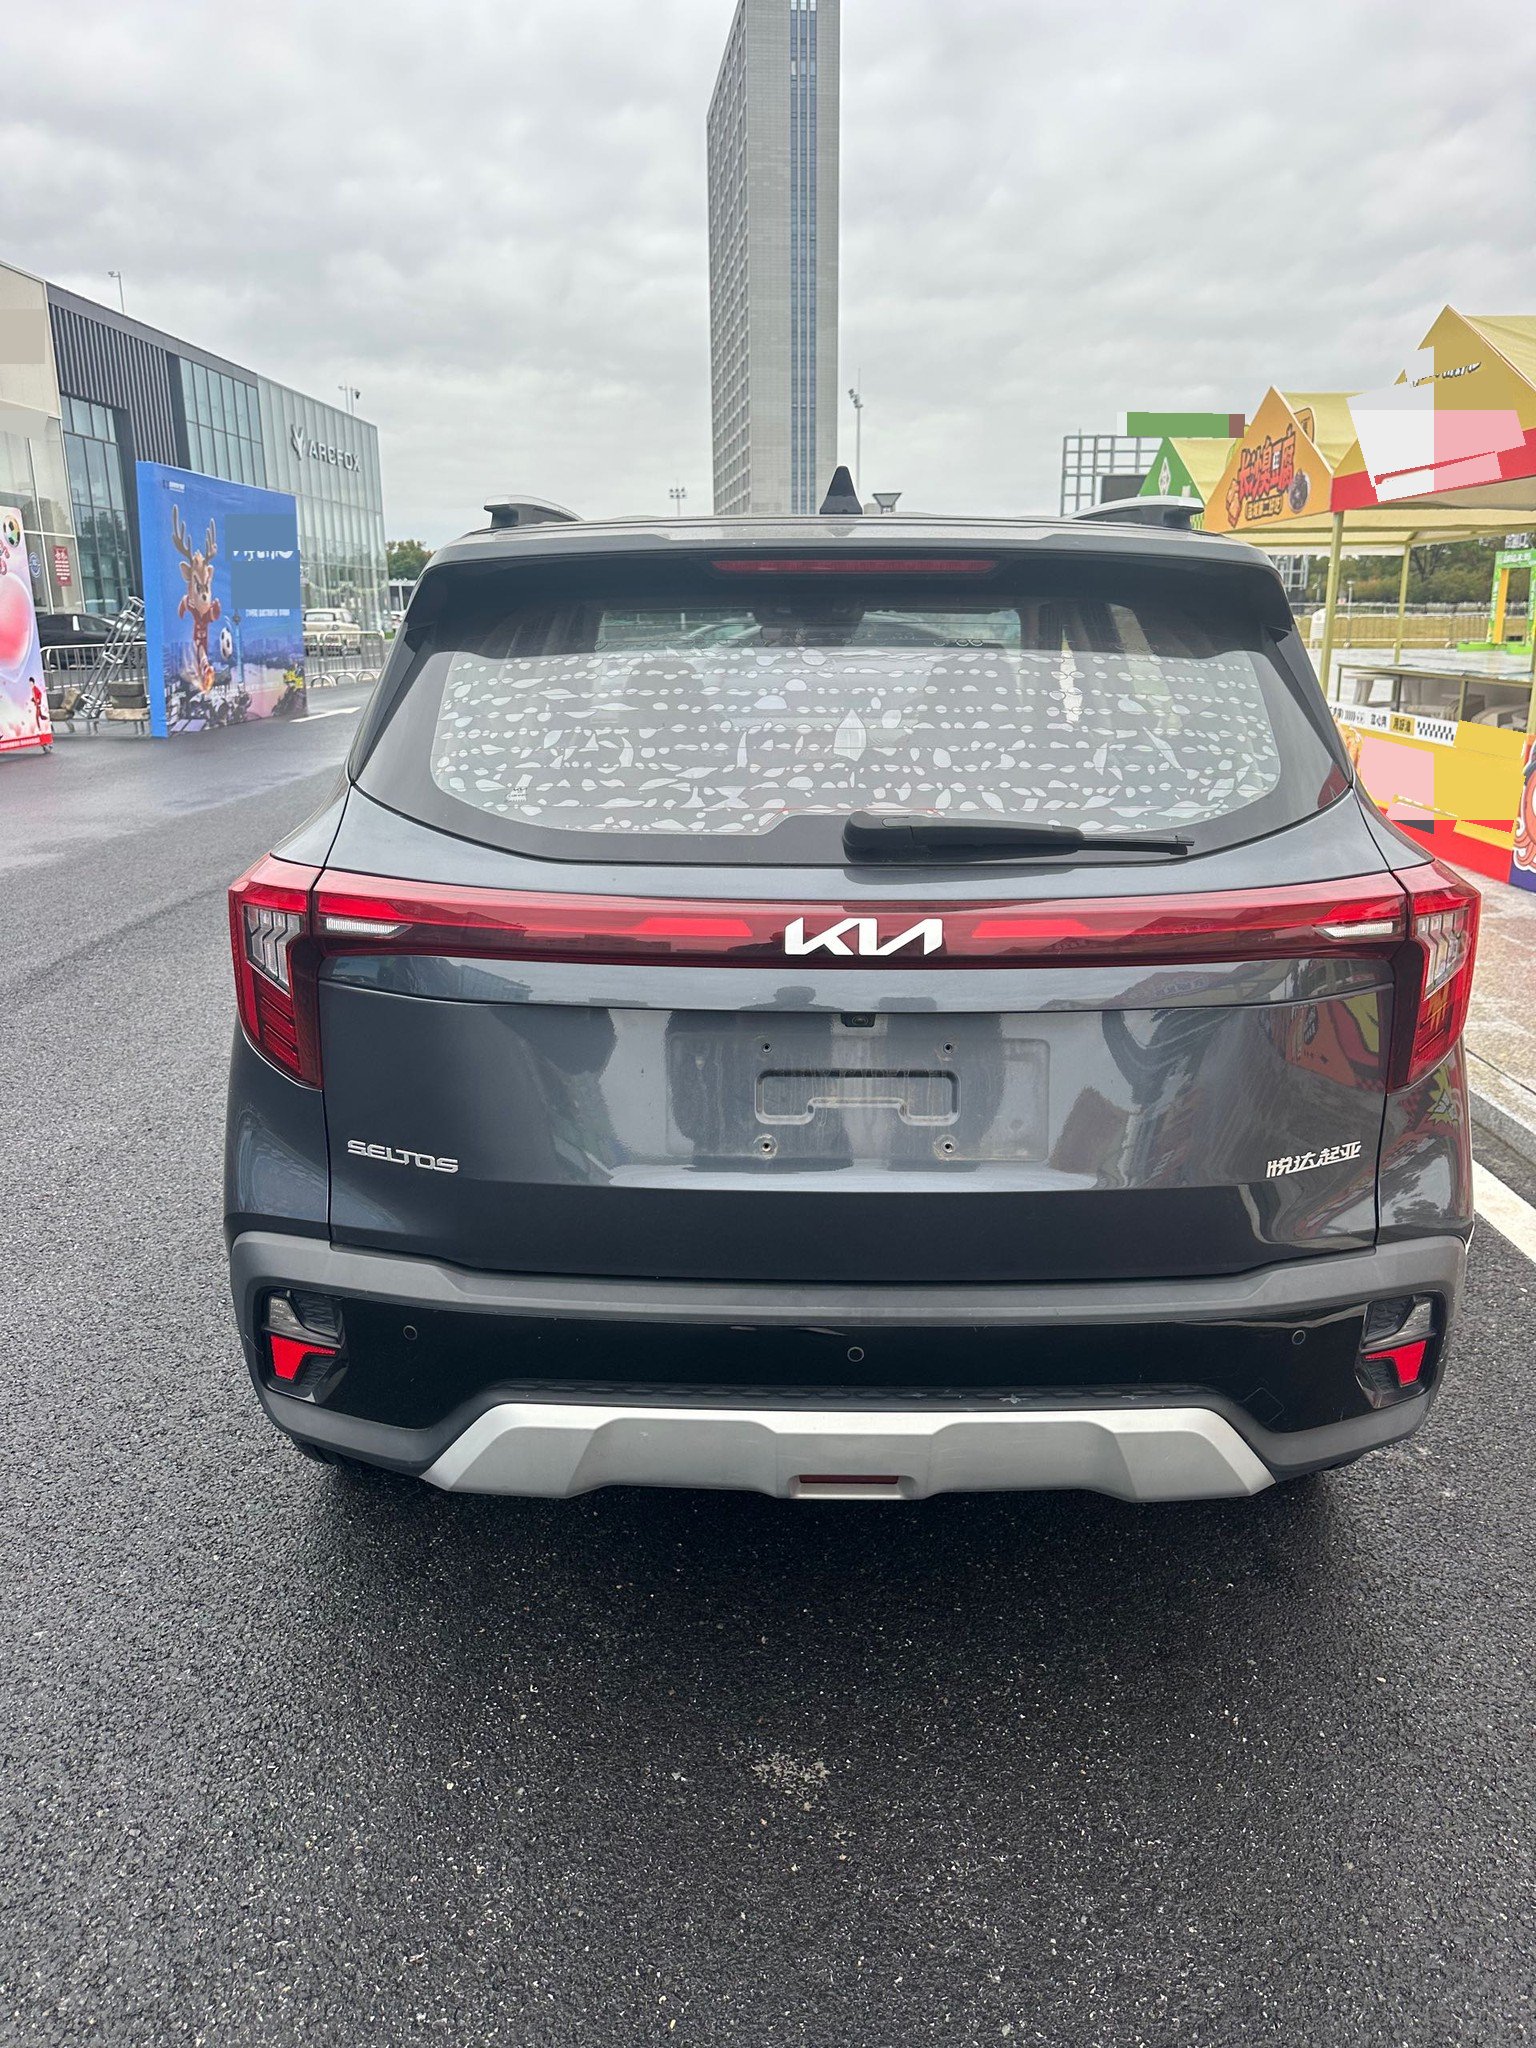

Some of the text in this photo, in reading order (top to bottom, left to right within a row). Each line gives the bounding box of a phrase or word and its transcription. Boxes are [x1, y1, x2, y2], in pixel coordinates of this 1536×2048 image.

[308, 439, 361, 472] ARCFOX
[785, 917, 943, 956] KIA
[347, 1139, 459, 1174] SELTOS
[1266, 1141, 1362, 1178] 悦达起亚
